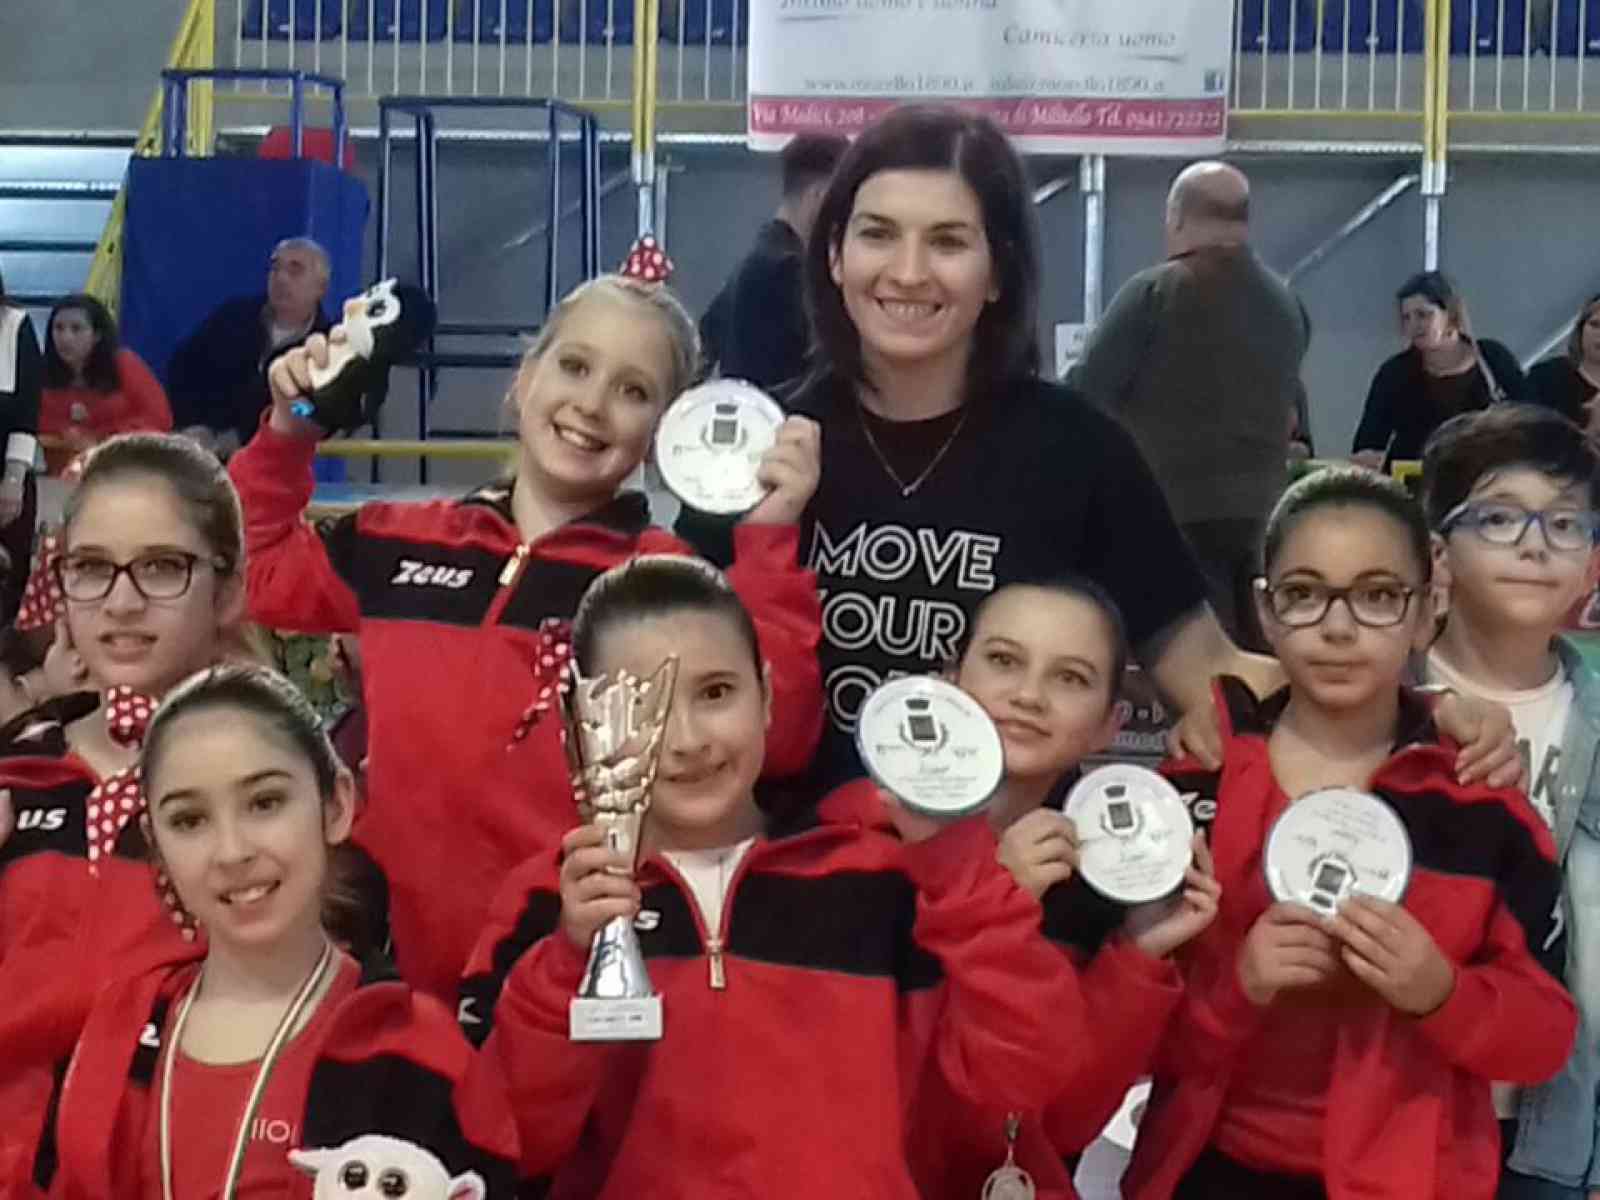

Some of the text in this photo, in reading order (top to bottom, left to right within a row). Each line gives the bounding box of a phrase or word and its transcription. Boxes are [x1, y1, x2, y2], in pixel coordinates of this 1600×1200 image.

[1003, 25, 1176, 47] Camiceria uomo
[752, 102, 776, 123] Via
[807, 519, 1001, 591] MOVE
[391, 559, 475, 589] Zeus
[816, 588, 967, 662] OUR
[17, 807, 68, 831] us
